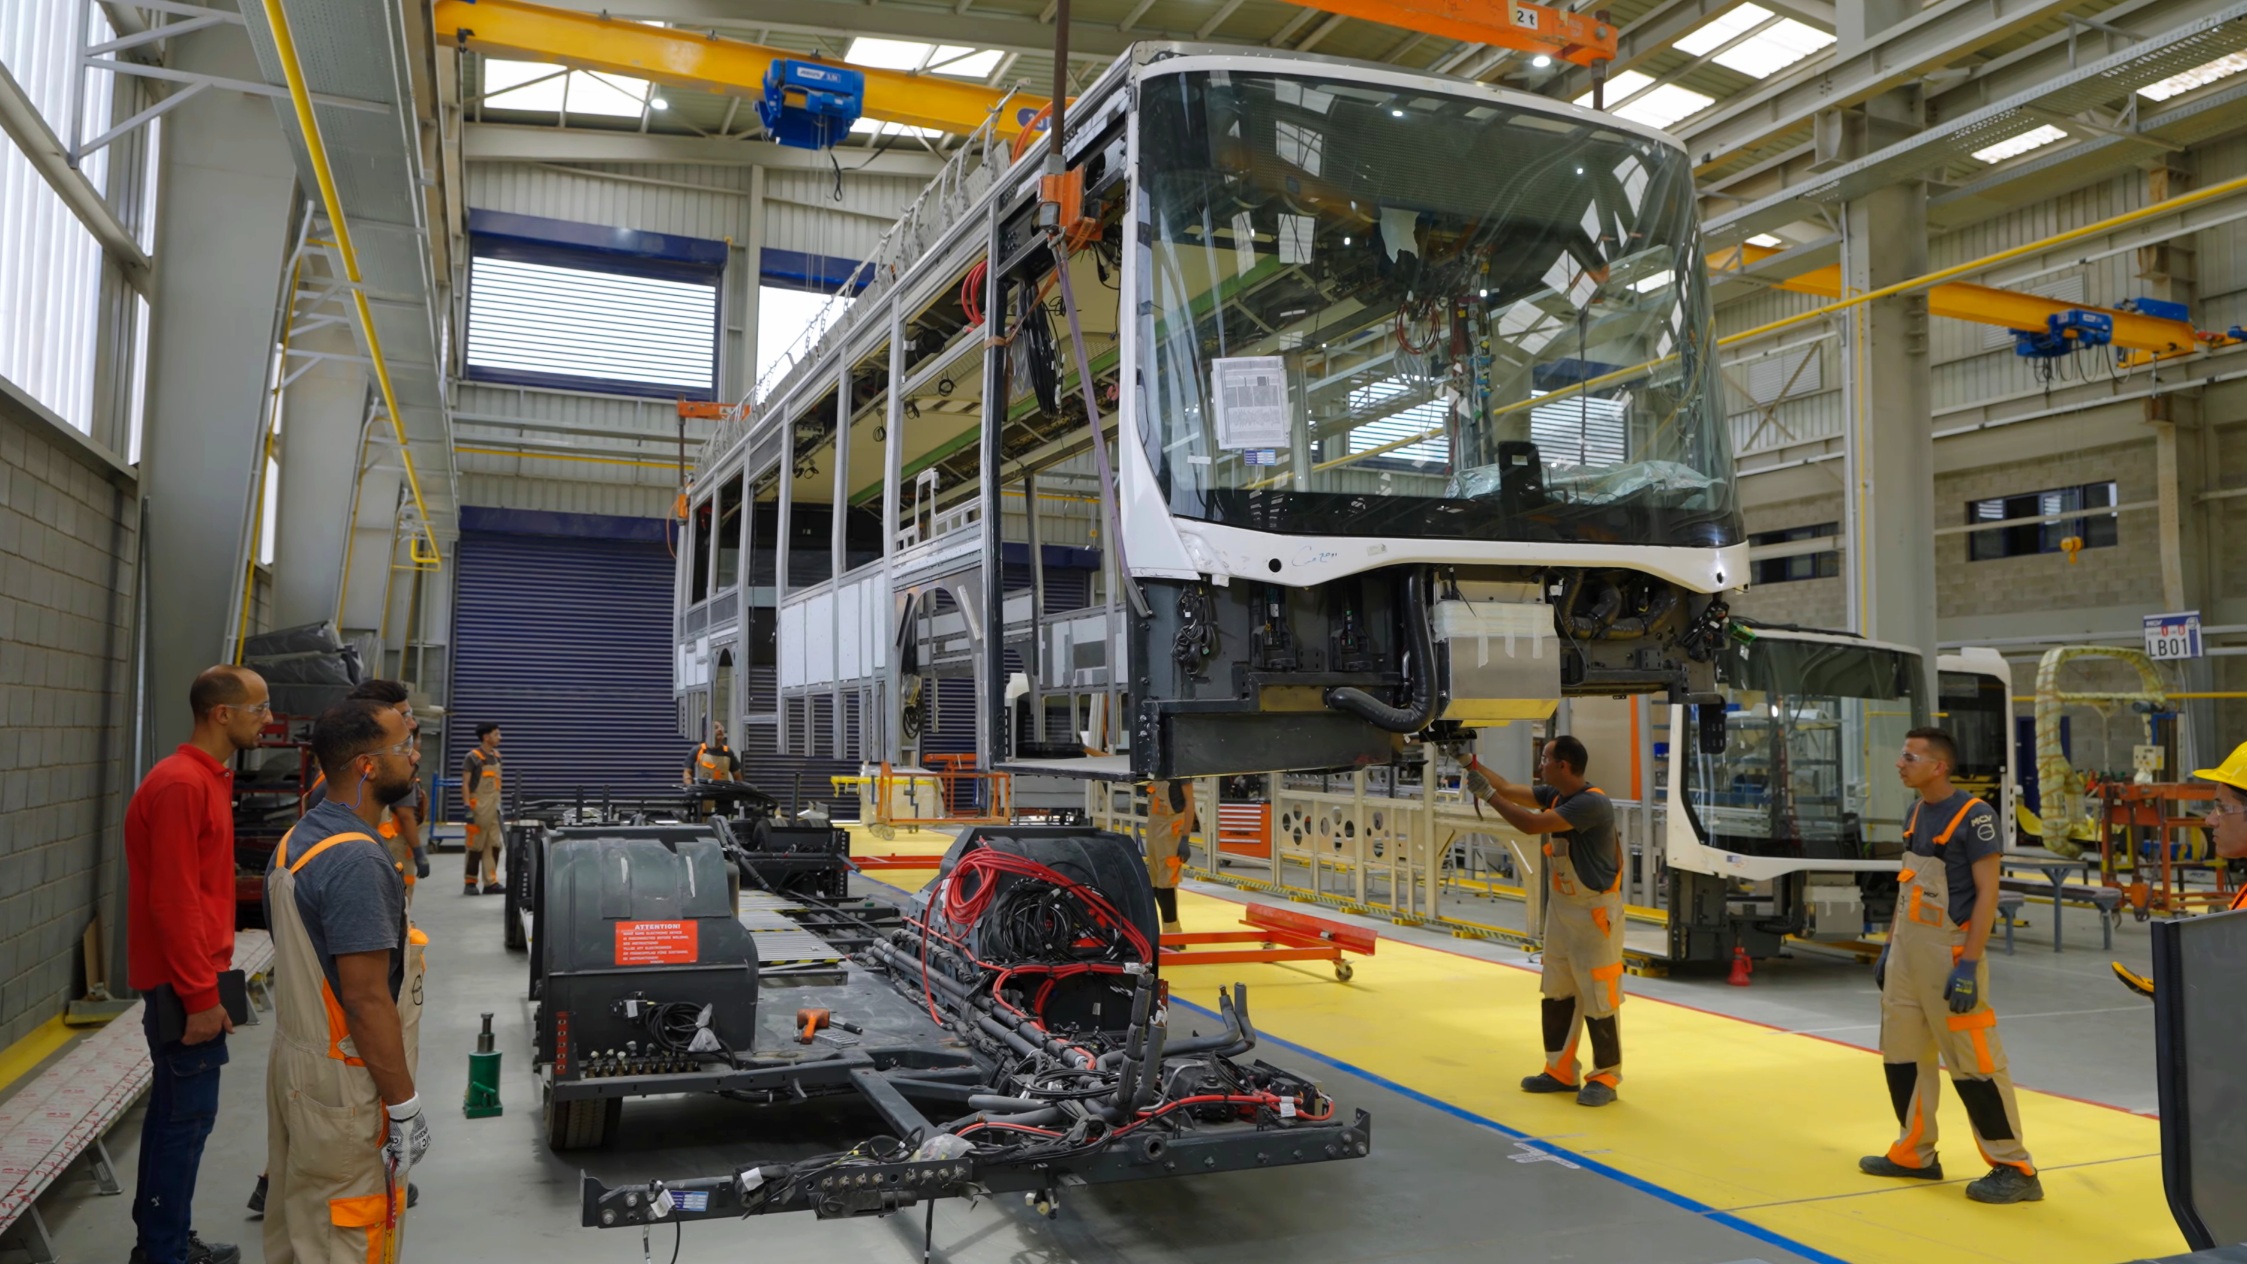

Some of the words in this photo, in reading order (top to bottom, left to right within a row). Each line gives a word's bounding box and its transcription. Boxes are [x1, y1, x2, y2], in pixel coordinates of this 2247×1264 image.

[1529, 13, 1536, 26] t
[2148, 638, 2188, 657] LB01
[1971, 815, 1992, 827] MCV
[634, 923, 681, 931] ATTENTION!
